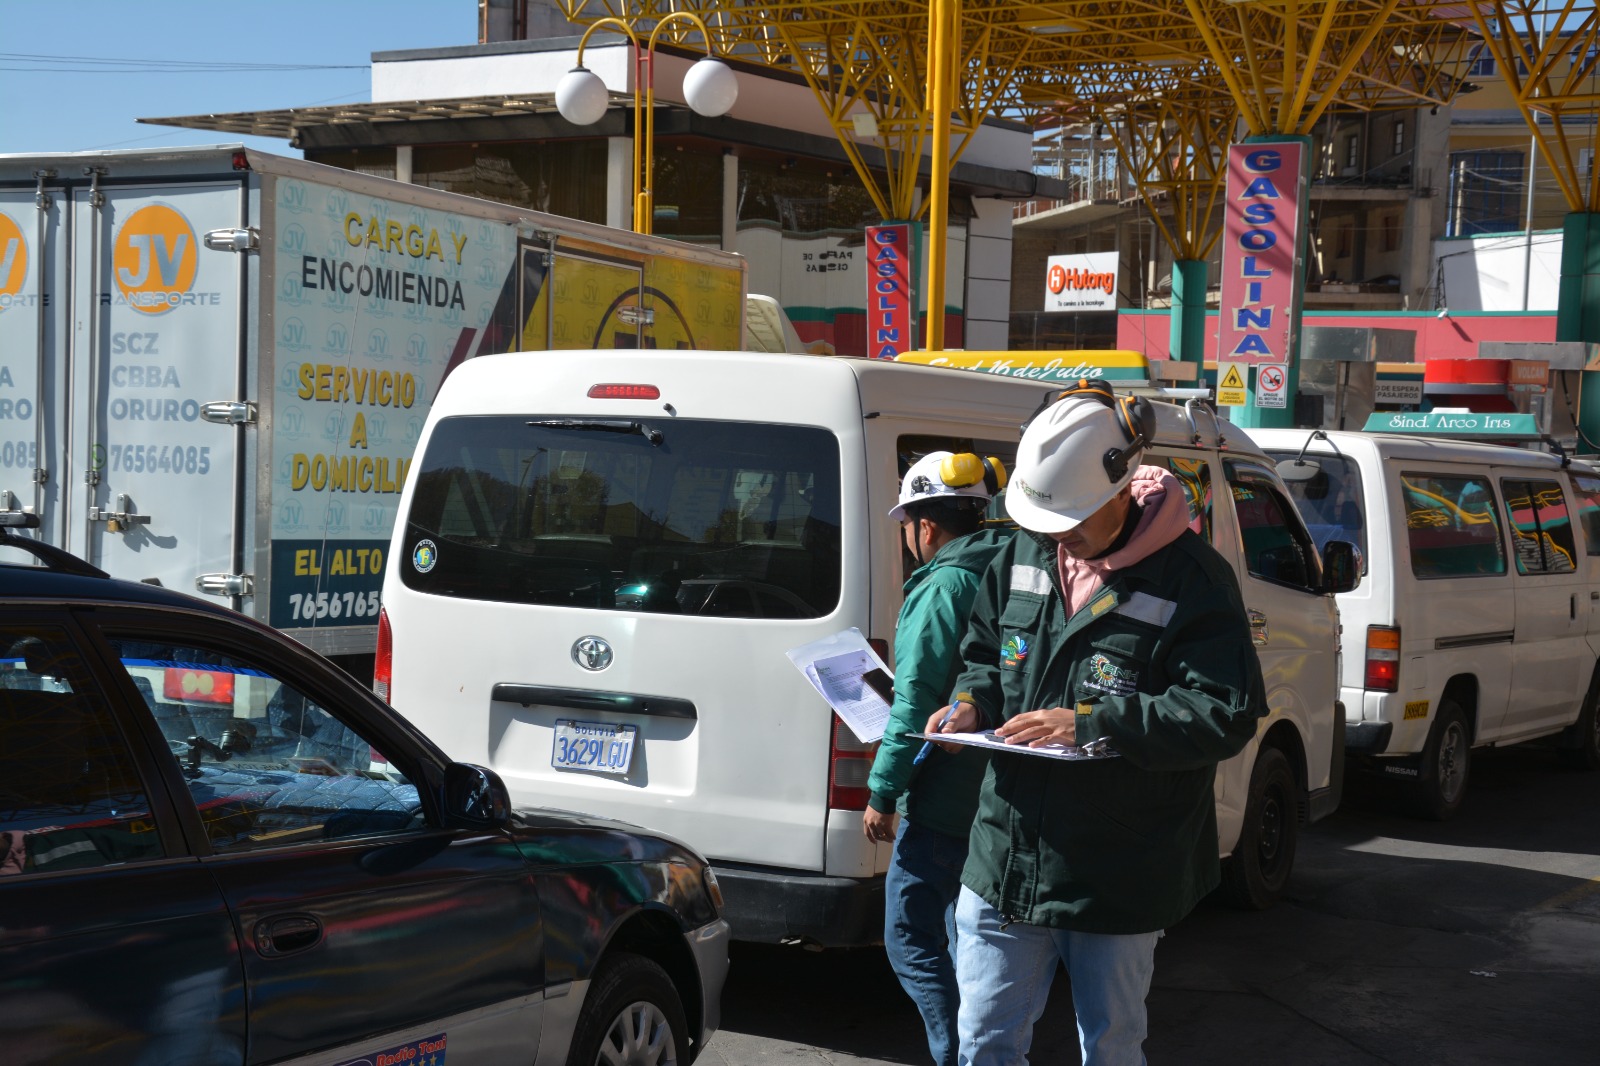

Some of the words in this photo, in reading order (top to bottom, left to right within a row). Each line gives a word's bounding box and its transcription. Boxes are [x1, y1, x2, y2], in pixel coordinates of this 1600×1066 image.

[344, 212, 444, 263] CARGA
[451, 231, 468, 265] Y
[118, 234, 188, 287] JV
[1229, 151, 1282, 357] GASOLINA
[302, 255, 466, 311] ENCOMIENDA
[875, 230, 899, 359] GASOLINA
[1066, 268, 1114, 295] Hutong
[96, 292, 221, 306] RANSPORTE
[112, 333, 159, 354] SCZ
[111, 366, 180, 388] CBBA
[298, 363, 415, 409] SERVICIO
[1517, 366, 1545, 379] VOLCAN
[110, 399, 200, 422] ORURO
[1389, 415, 1430, 428] Sind.
[1436, 416, 1477, 428] Arco
[1484, 416, 1511, 428] Iris
[349, 412, 368, 449] A
[110, 445, 210, 475] 76564085
[294, 550, 321, 576] EL
[330, 549, 383, 576] ALTO
[289, 591, 383, 620] 7656765
[575, 726, 615, 737] BOLIVIA
[557, 736, 629, 768] 3629LGU
[1385, 766, 1418, 776] NISSAN
